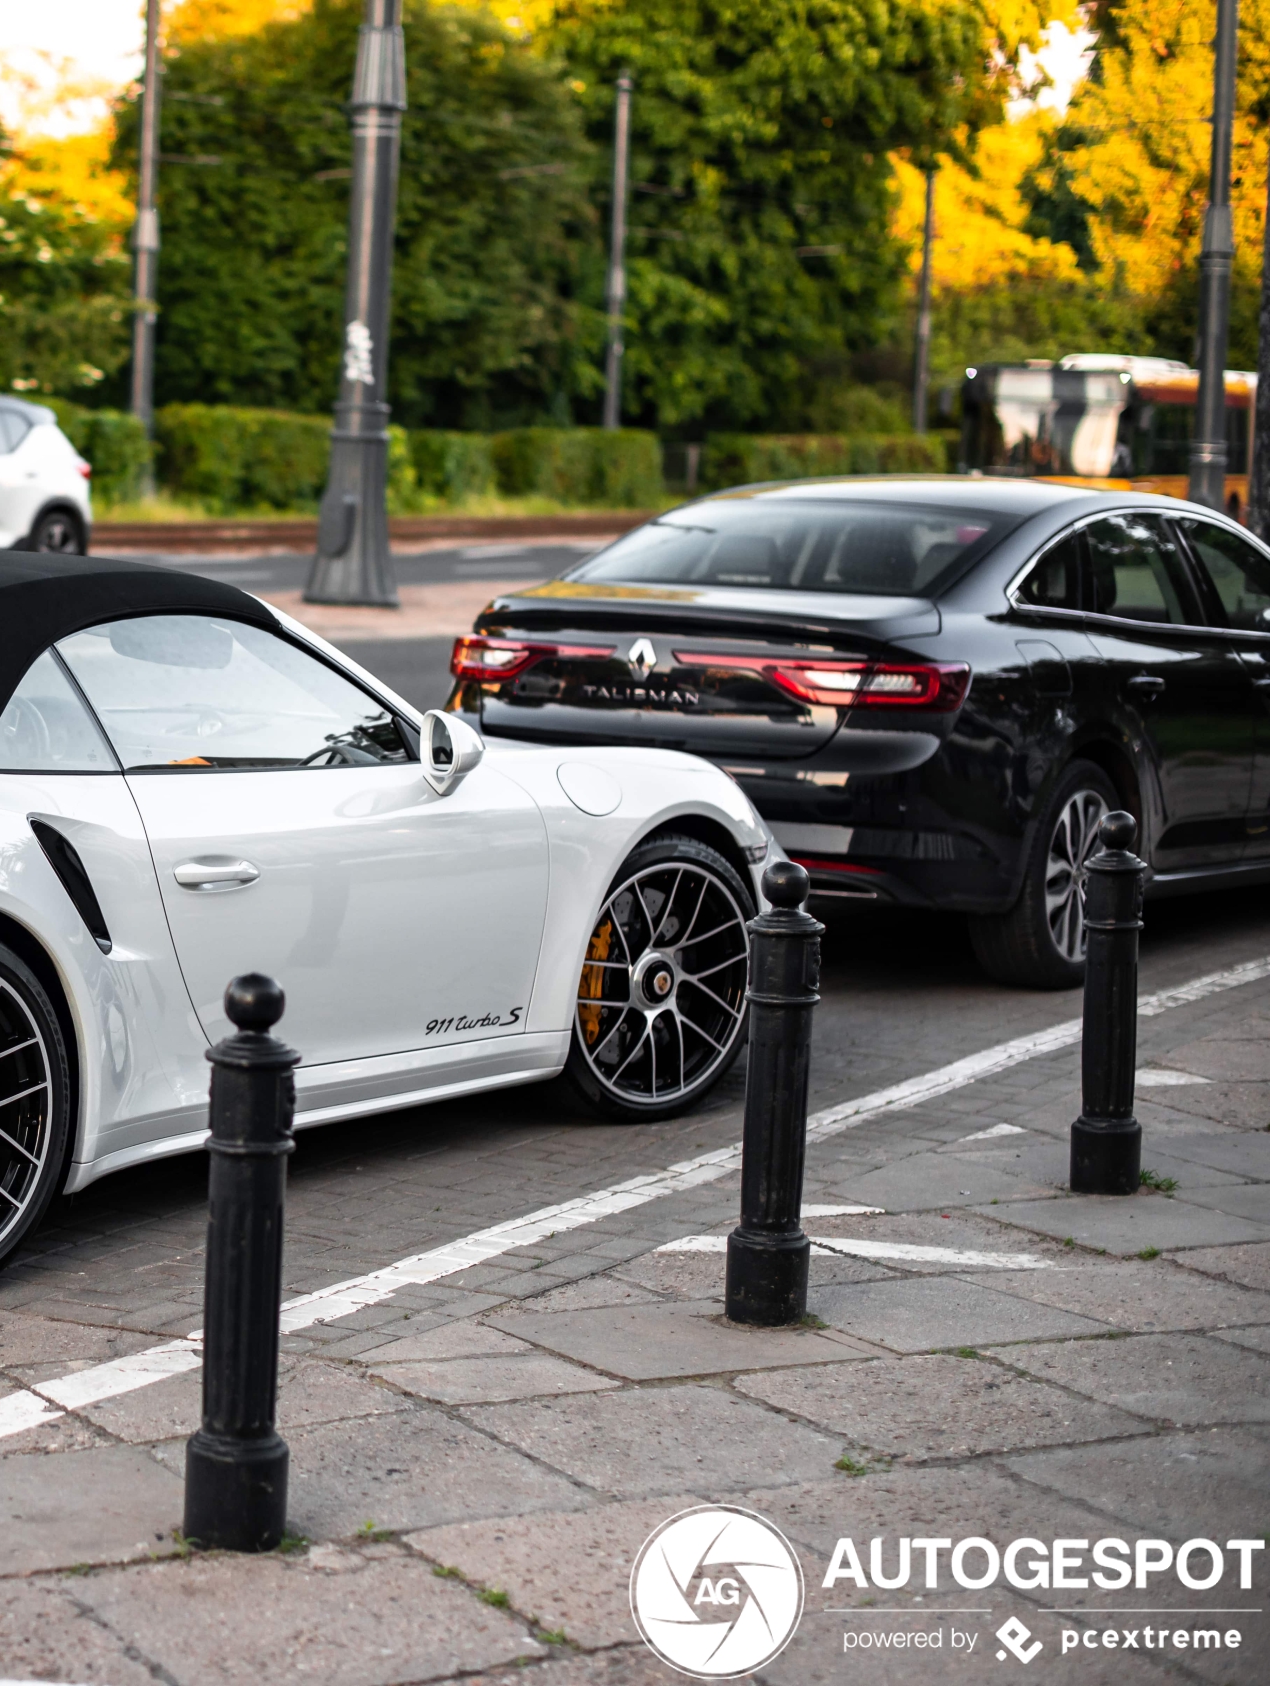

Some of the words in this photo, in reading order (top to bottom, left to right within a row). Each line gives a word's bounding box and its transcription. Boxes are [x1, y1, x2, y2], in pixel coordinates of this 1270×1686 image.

[583, 685, 699, 705] TALISMAN
[425, 1017, 455, 1035] 911
[455, 1012, 500, 1031] turbo
[499, 1007, 523, 1026] S
